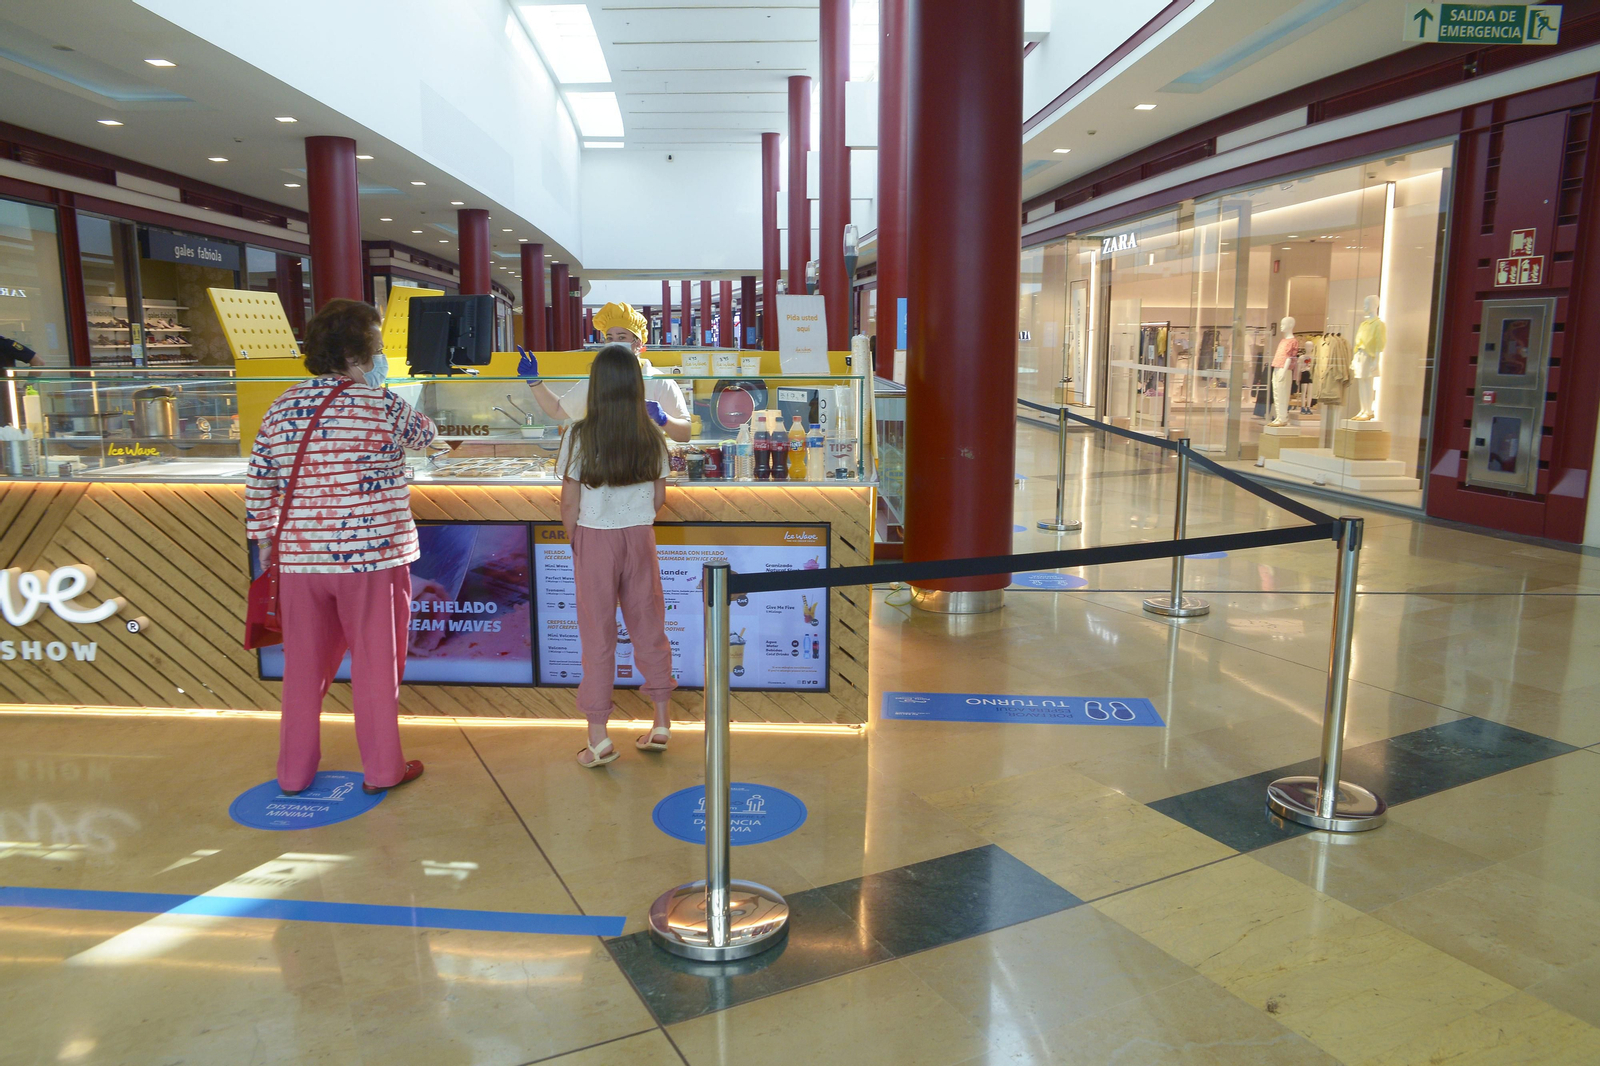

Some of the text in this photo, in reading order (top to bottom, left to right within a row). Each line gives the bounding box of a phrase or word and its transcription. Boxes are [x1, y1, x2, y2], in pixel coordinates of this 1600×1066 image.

[1450, 9, 1517, 22] SALIDA DE
[1440, 25, 1522, 38] EMERGENCIA
[1102, 232, 1138, 254] ZARA
[174, 244, 222, 262] gales fabiola
[796, 324, 810, 333] aquí
[107, 442, 125, 456] Ice
[829, 444, 852, 452] TIPS
[541, 530, 570, 539] CAR
[784, 531, 795, 540] Ice
[410, 601, 498, 614] DE HELADO
[448, 620, 502, 632] WAVES
[0, 640, 98, 661] SHOW
[966, 698, 1038, 707] TURNO
[266, 803, 330, 812] DISTANCIA
[266, 810, 314, 818] MÍNIMA
